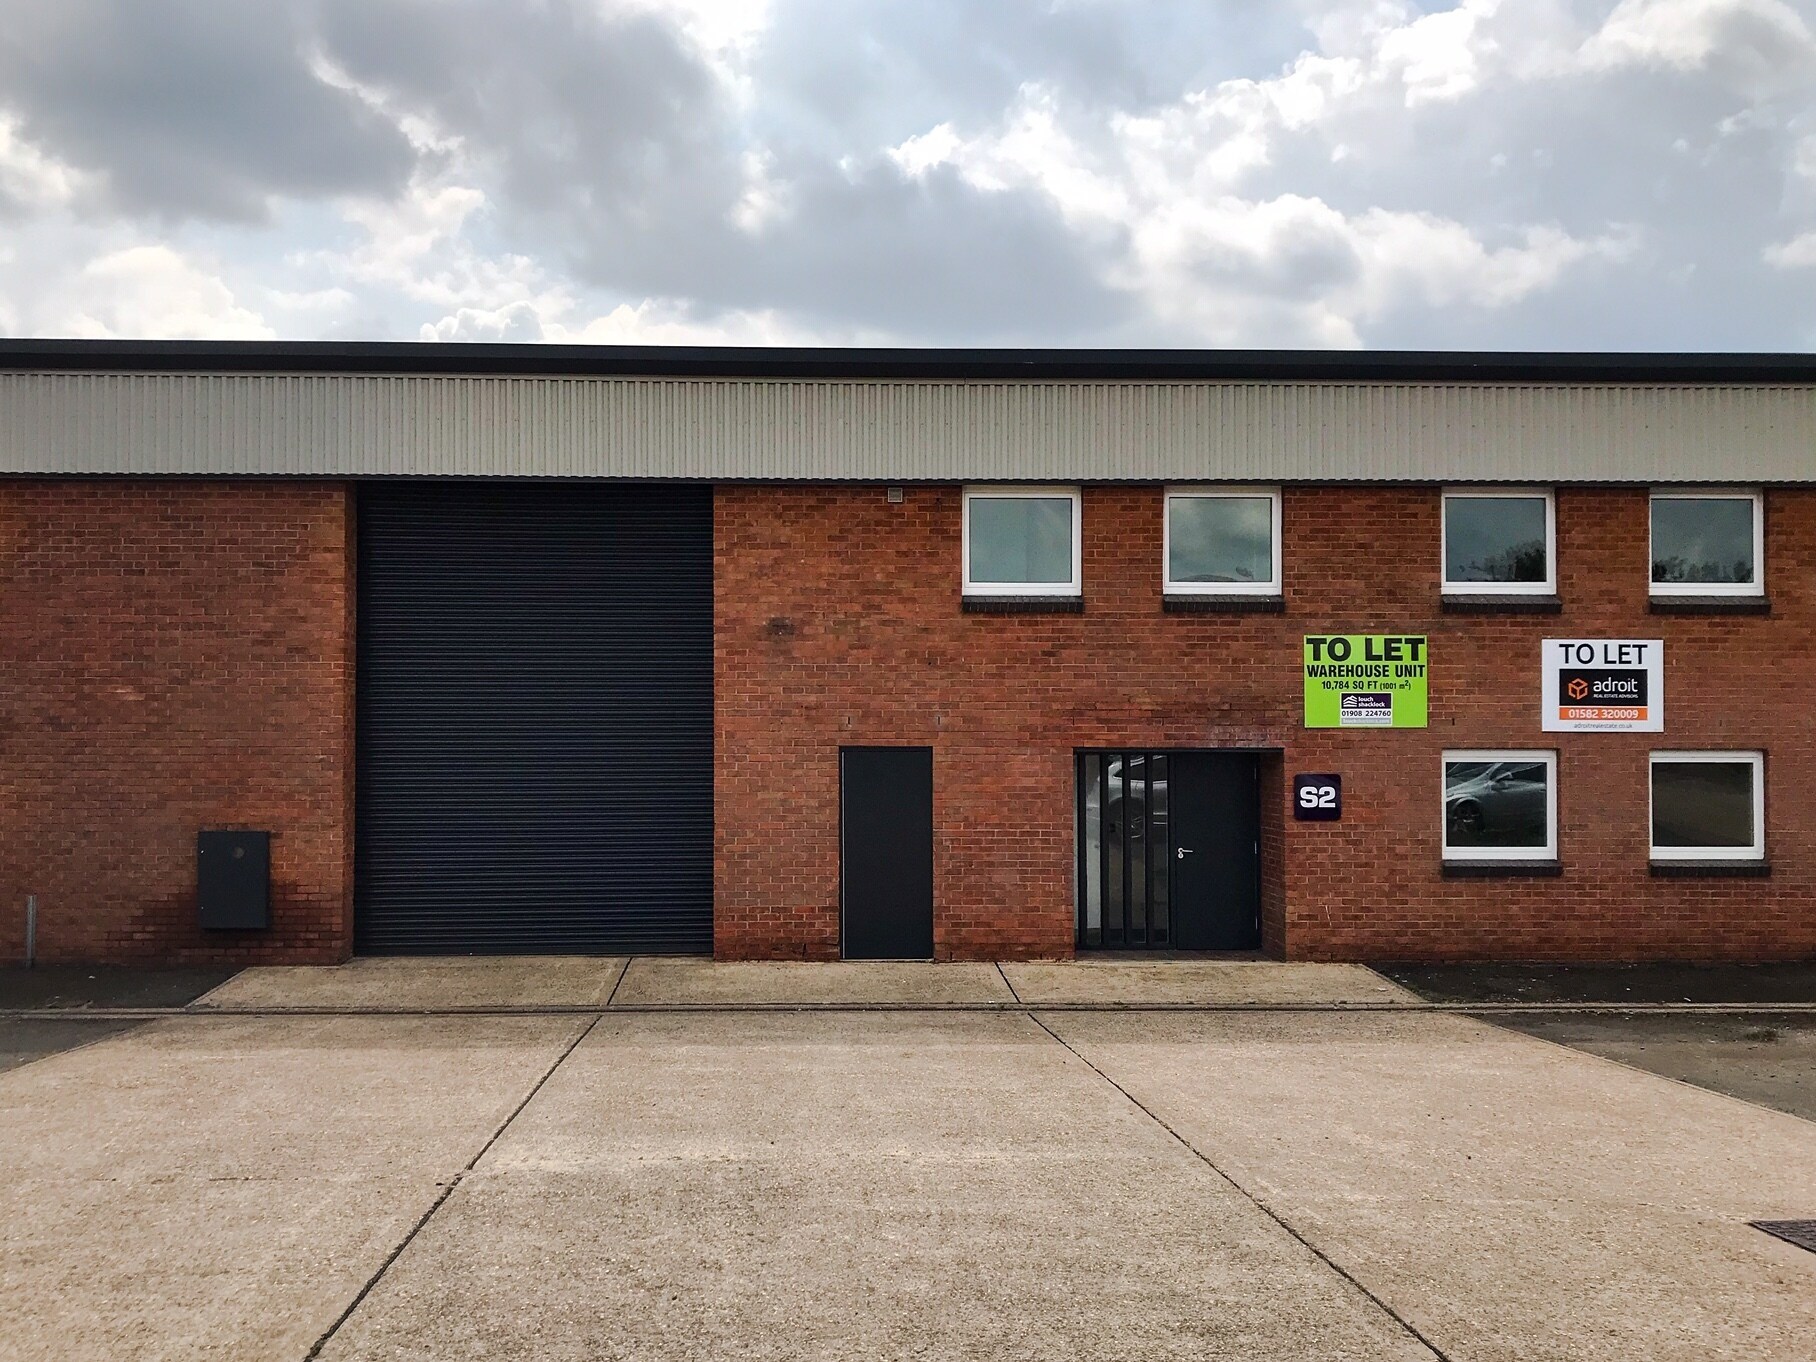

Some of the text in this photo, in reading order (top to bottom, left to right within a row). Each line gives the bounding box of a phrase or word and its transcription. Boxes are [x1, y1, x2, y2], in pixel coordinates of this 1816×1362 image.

[1306, 637, 1425, 661] TO LET
[1559, 643, 1648, 664] TO LET
[1307, 665, 1425, 677] WAREHOUSE UNIT
[1322, 680, 1349, 690] 10,784
[1352, 680, 1364, 690] SQ
[1367, 681, 1378, 690] FT
[1593, 677, 1638, 692] adroit
[1568, 709, 1639, 718] 01582 320009
[1300, 786, 1336, 808] S2
